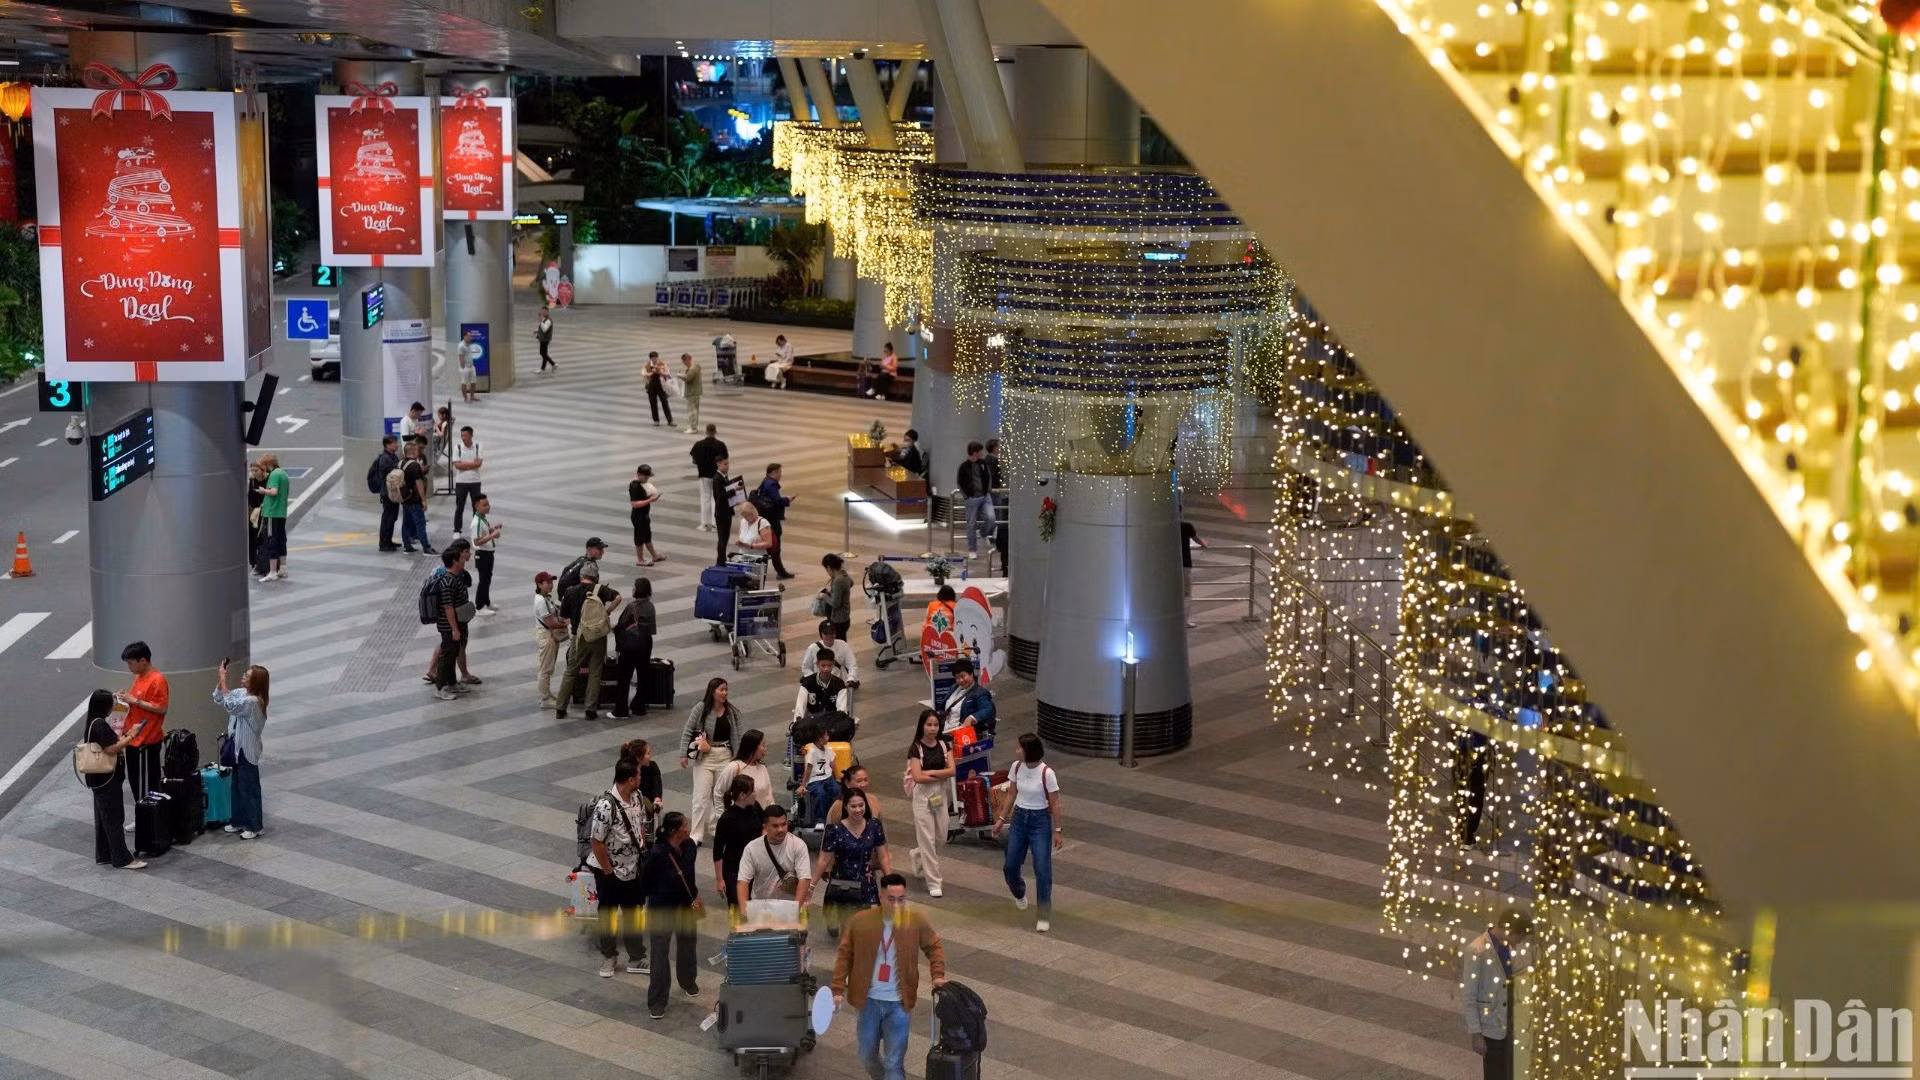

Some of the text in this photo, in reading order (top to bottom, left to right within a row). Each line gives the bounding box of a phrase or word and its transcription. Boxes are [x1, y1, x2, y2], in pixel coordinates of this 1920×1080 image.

[446, 173, 473, 185] Ding
[462, 182, 493, 196] Deal
[340, 201, 379, 217] Ding
[362, 215, 406, 233] Deal
[317, 265, 331, 286] 2
[80, 272, 149, 298] Ding
[119, 294, 195, 325] Deal
[49, 380, 71, 408] 3
[817, 761, 827, 771] 7
